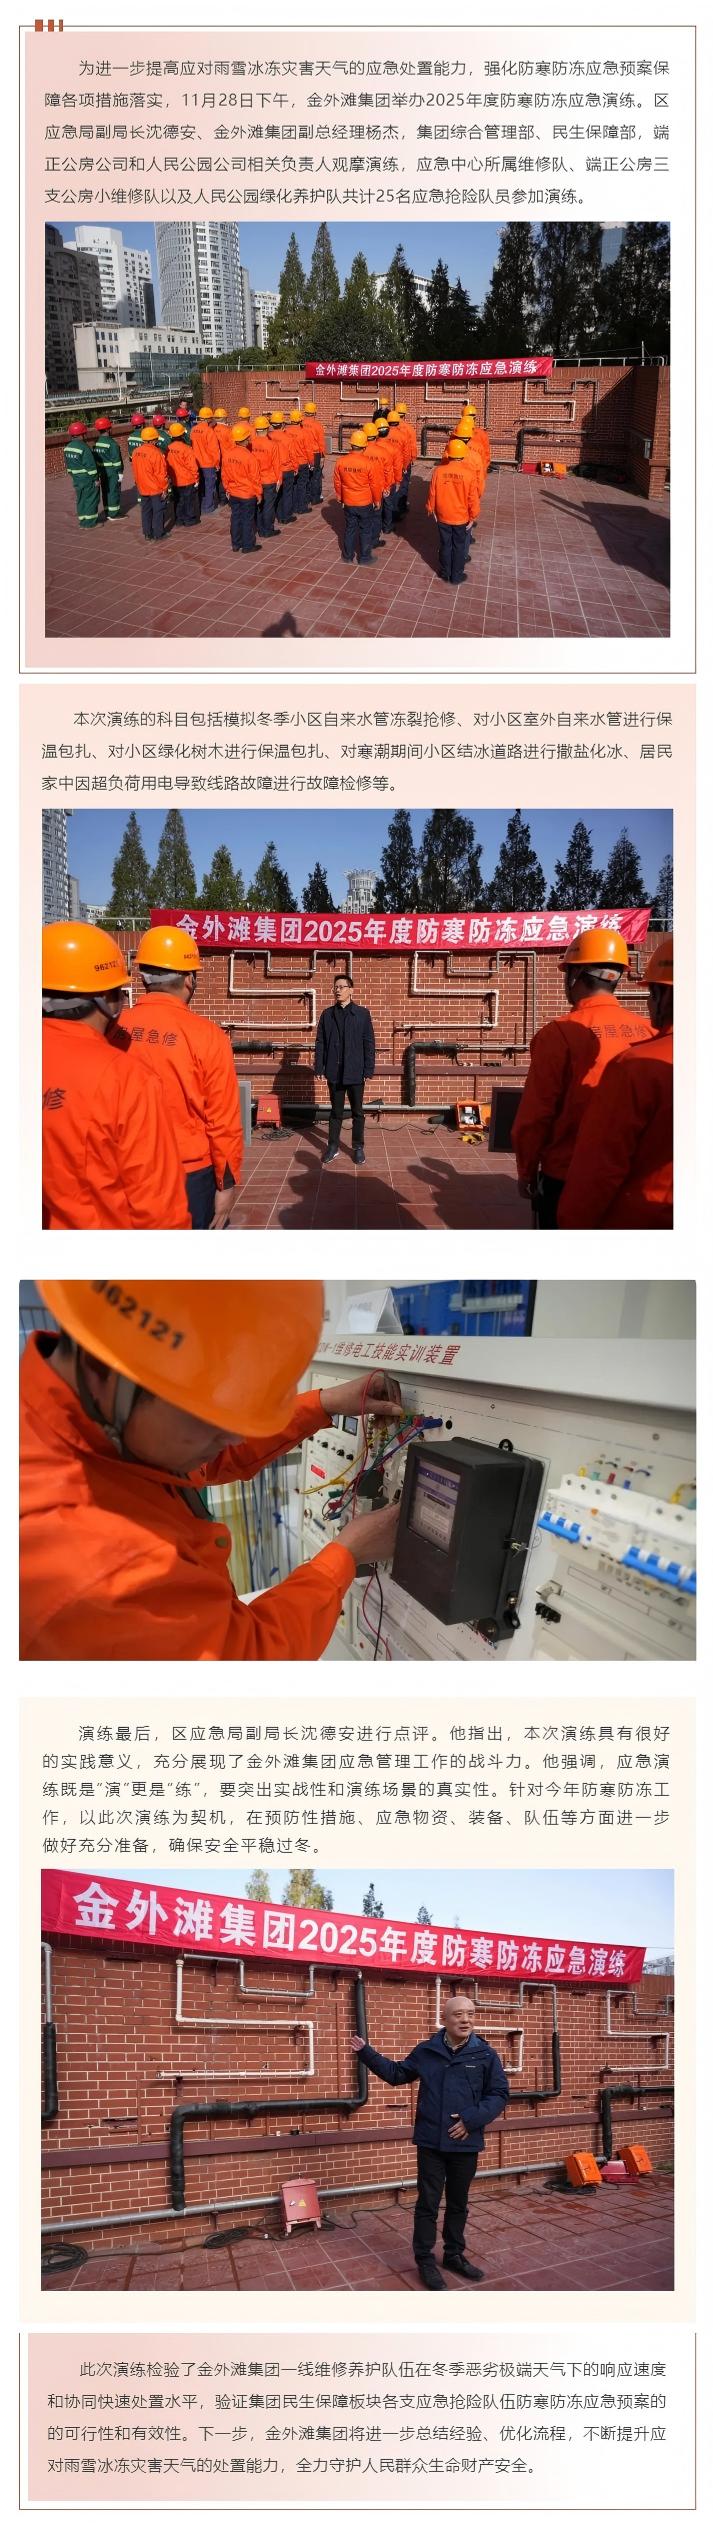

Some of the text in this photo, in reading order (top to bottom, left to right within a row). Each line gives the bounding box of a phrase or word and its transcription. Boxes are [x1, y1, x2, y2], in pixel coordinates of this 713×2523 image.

[315, 360, 538, 377] 金外滩集团2025年度防寒防冻应急演练
[73, 1881, 626, 1977] 金外滩集团2025年度防寒防冻应急演练
